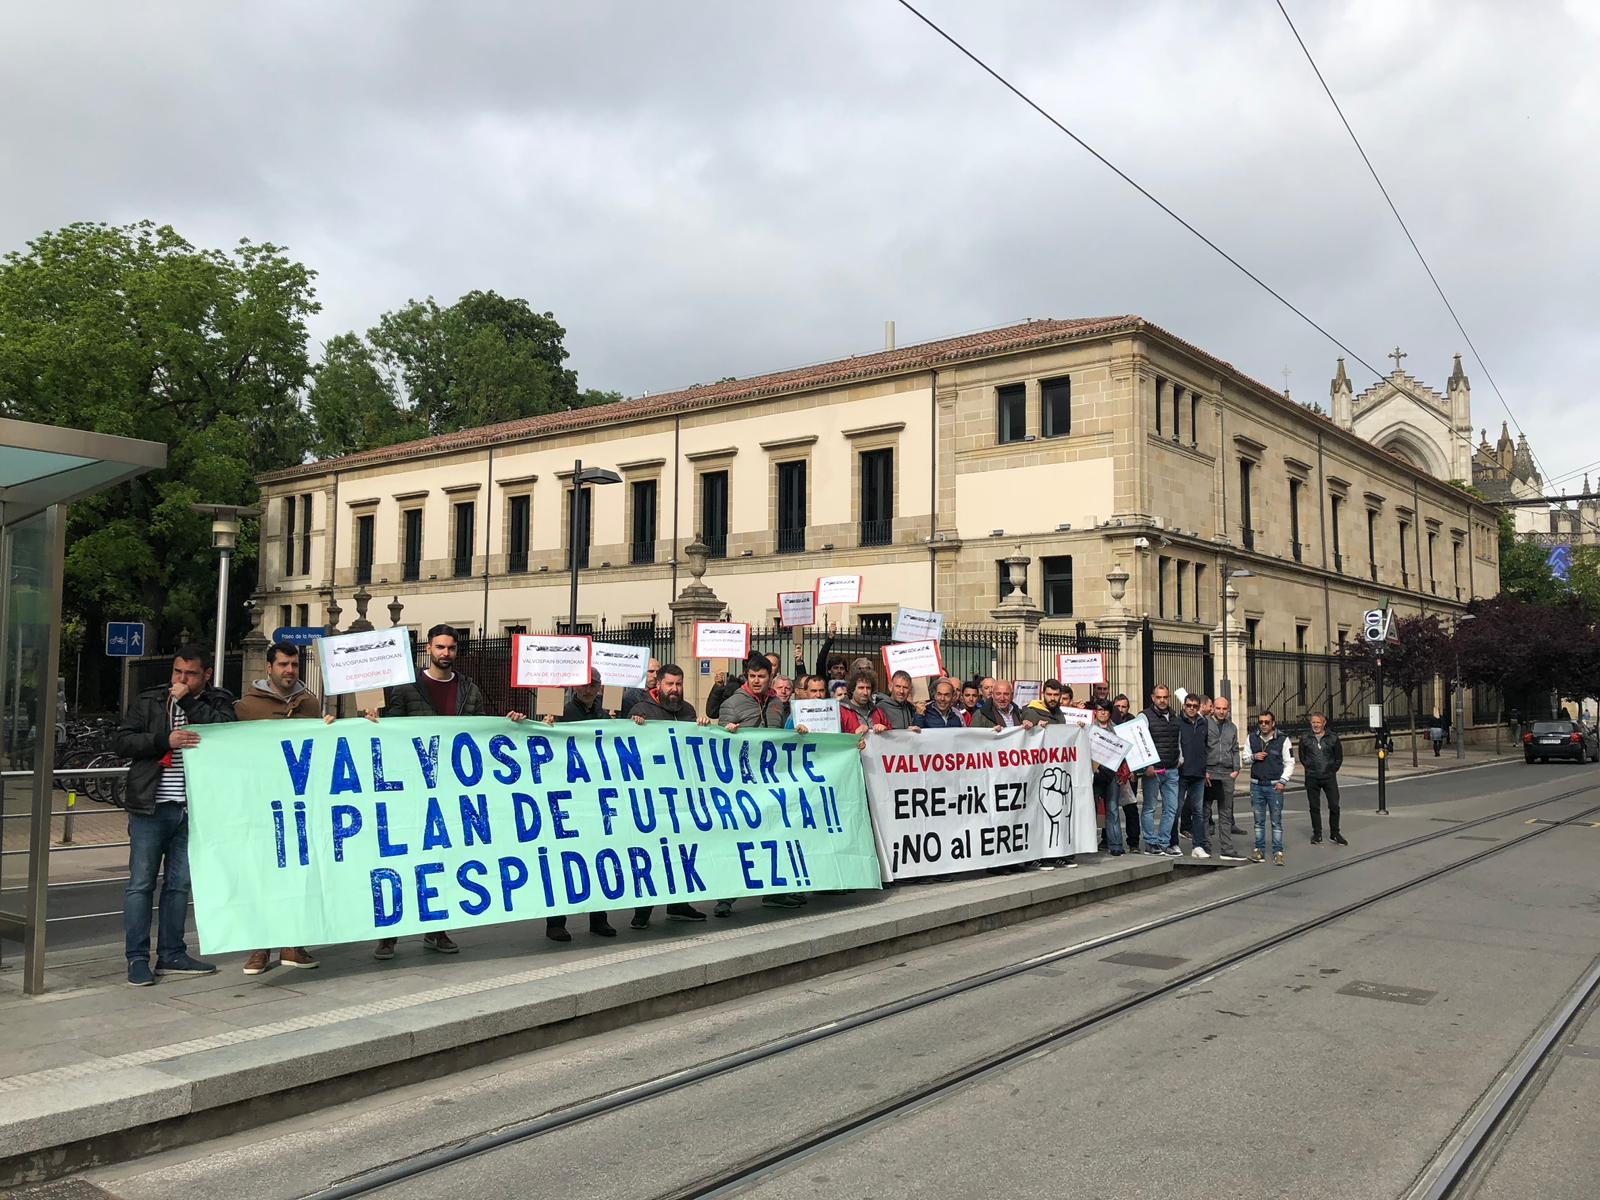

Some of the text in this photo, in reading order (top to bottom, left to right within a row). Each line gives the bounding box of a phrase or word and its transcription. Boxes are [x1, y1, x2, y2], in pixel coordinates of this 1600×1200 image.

[882, 751, 994, 774] VALVOSPAIN
[998, 746, 1077, 768] BORROKAN
[512, 790, 579, 843] DE
[597, 786, 762, 835] FUTURO
[894, 782, 1027, 820] ERE-rik EZ!
[736, 839, 811, 890] EZ!!
[892, 823, 1029, 873] ¡NO al ERE!
